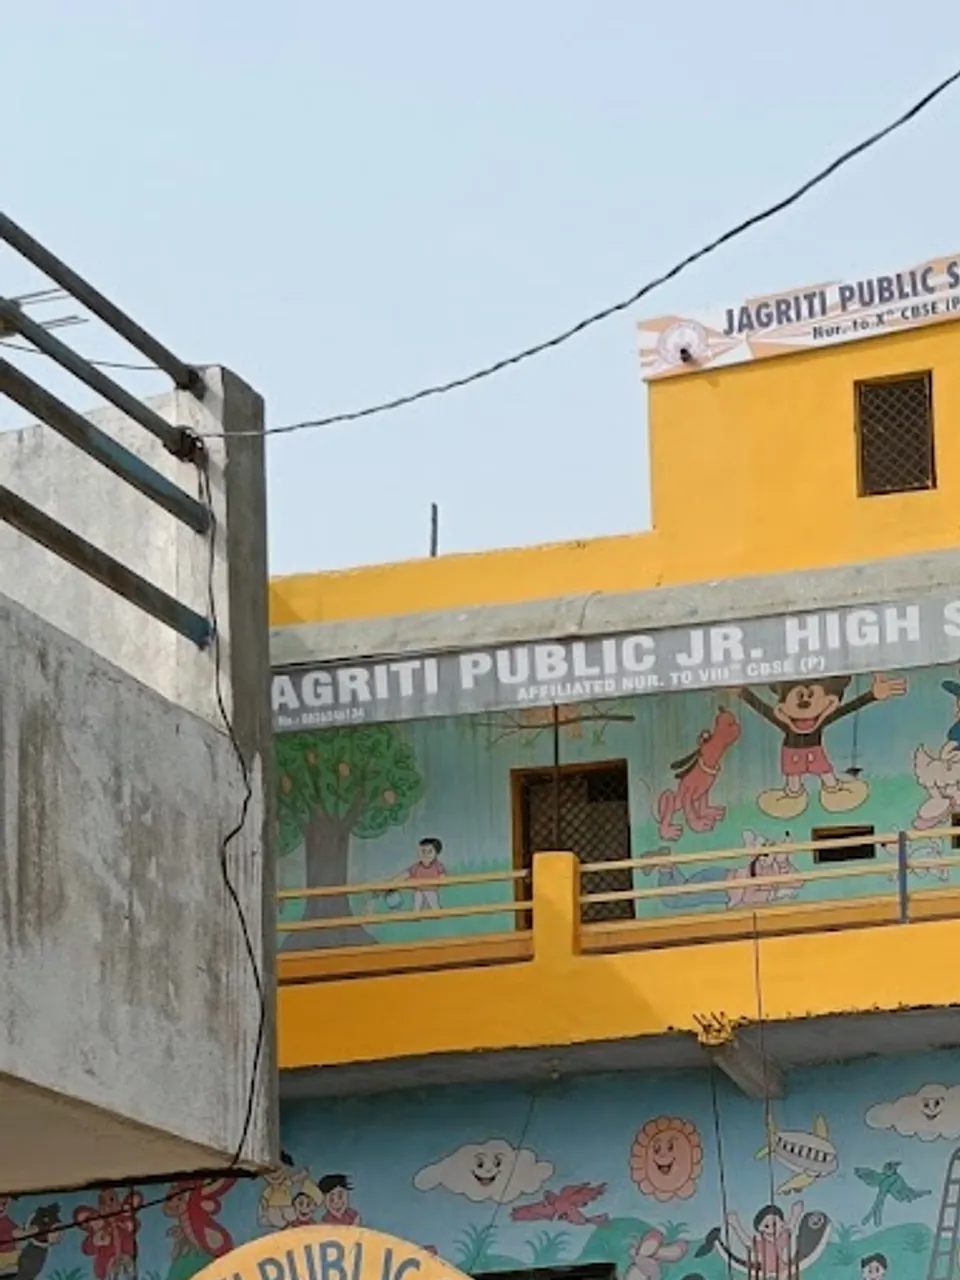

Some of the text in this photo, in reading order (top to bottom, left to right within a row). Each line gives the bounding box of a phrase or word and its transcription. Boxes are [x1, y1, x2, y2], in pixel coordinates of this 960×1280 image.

[722, 290, 828, 336] JAGRITI
[838, 266, 935, 314] PUBLIC
[901, 301, 940, 321] CBSE
[270, 658, 440, 712] AGRITI
[459, 634, 657, 690] PUBLIC
[676, 624, 764, 668] JR.
[785, 604, 921, 657] HIGH
[517, 678, 617, 701] AFFILIATED
[622, 674, 665, 692] NUR.
[670, 671, 693, 686] TO
[747, 660, 796, 677] CBSE
[800, 655, 827, 672] (P)
